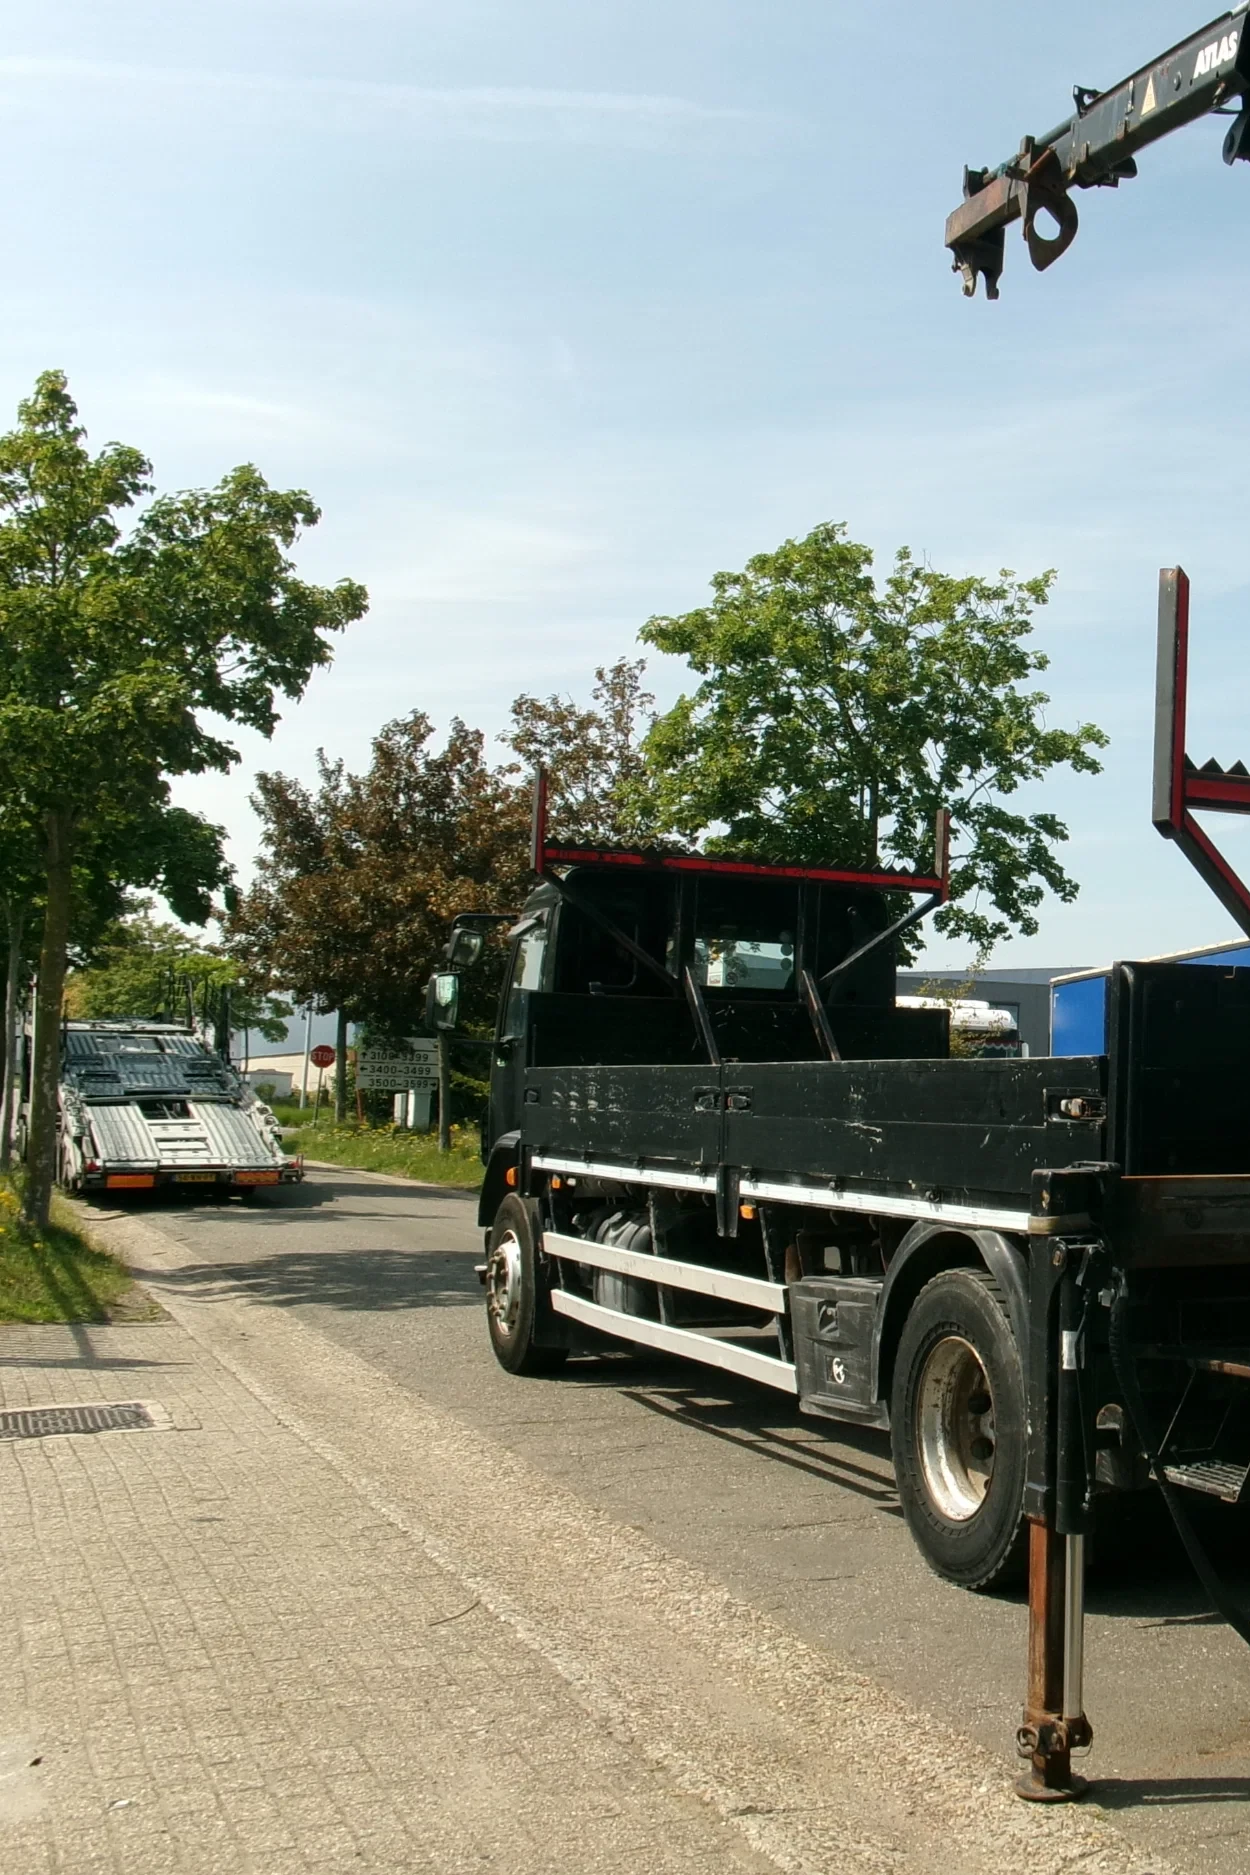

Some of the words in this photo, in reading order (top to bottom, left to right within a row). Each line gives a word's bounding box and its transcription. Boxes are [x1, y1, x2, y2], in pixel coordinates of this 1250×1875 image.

[1193, 31, 1238, 79] ATLAS
[311, 1051, 335, 1061] STOP
[369, 1064, 431, 1076] 3400-3499
[368, 1078, 428, 1088] 3500-3599
